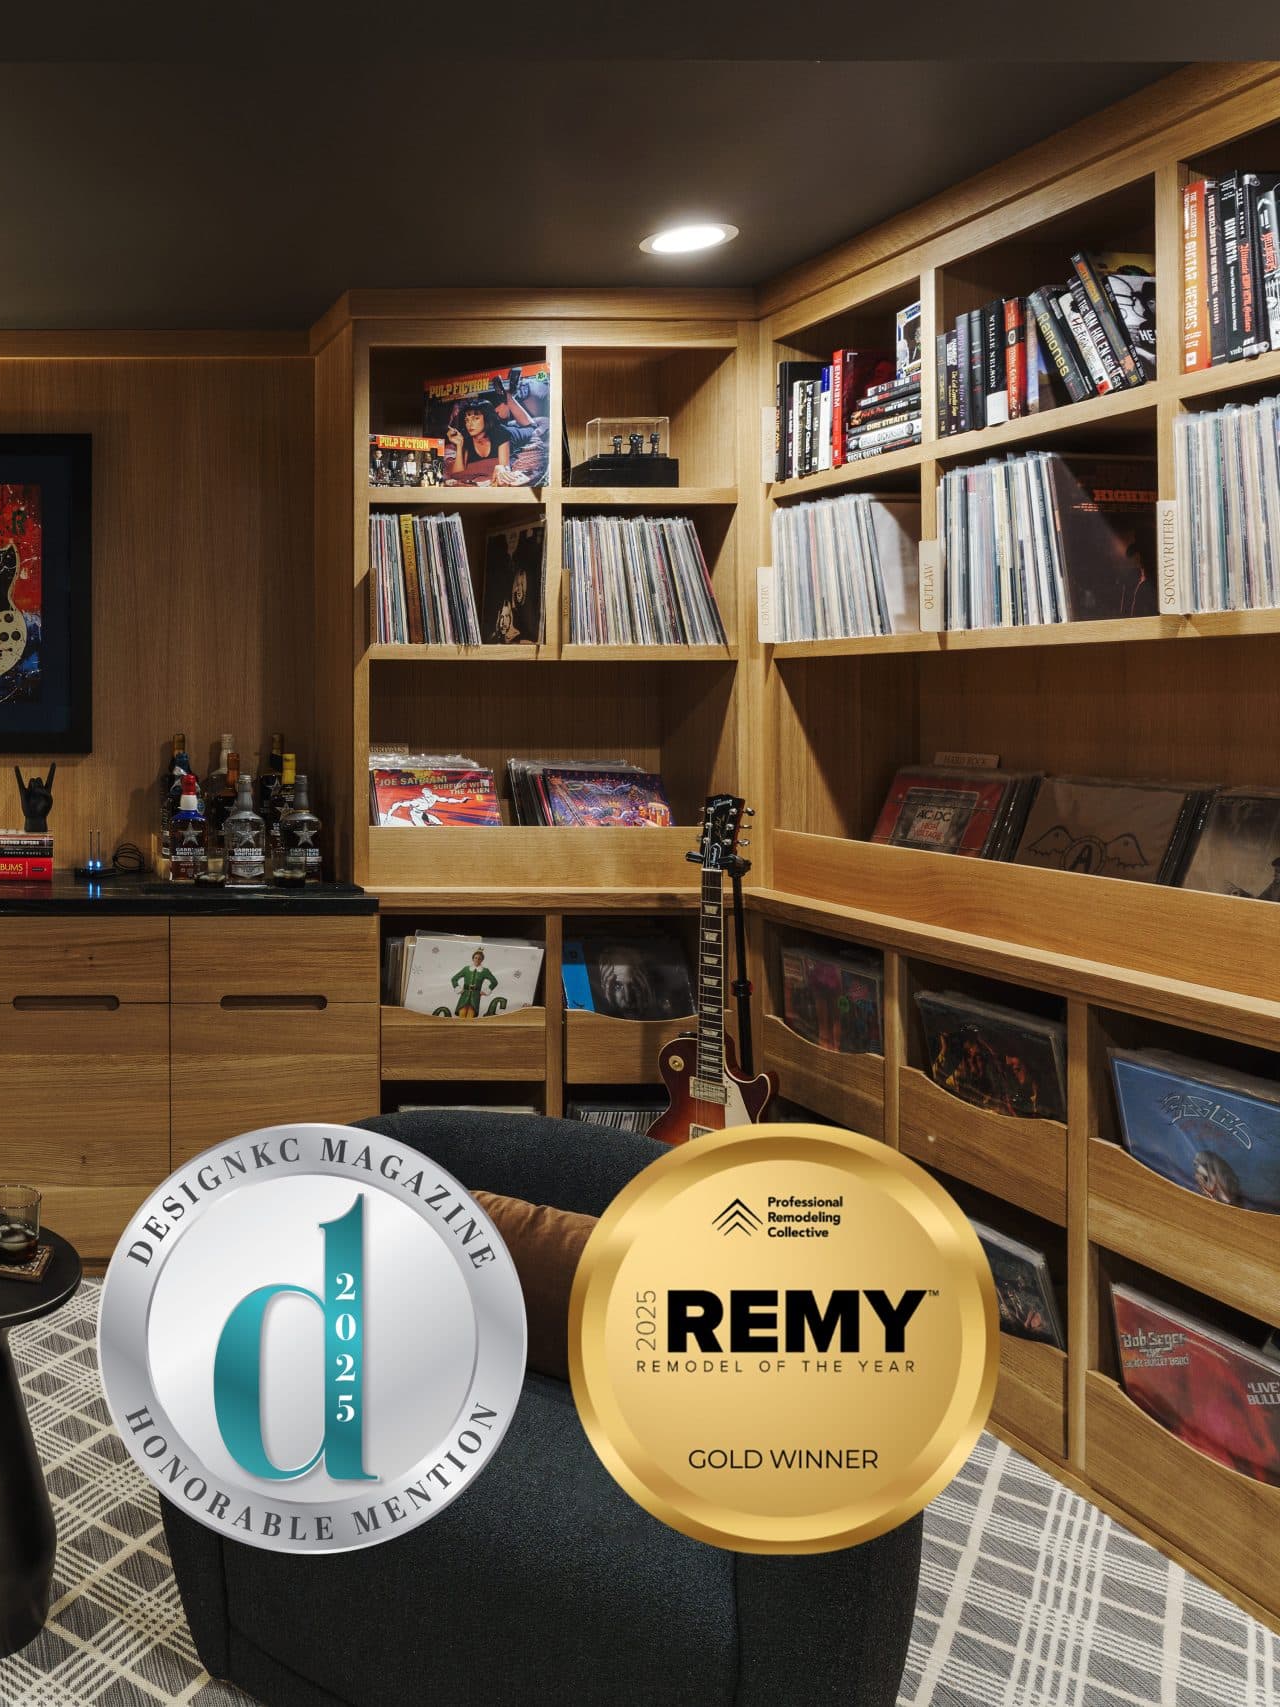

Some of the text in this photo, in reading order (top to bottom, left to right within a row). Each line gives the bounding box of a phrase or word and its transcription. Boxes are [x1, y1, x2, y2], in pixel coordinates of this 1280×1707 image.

[1224, 217, 1238, 265] HEAVY METAL
[1185, 241, 1198, 330] GUITAR HEROES
[1077, 299, 1089, 315] THE
[1084, 311, 1099, 330] VAN
[1037, 312, 1069, 377] Ramones
[1090, 328, 1109, 356] HALEN
[1101, 353, 1117, 373] SAGA
[428, 382, 452, 399] PULP
[452, 377, 490, 395] FICTION
[379, 437, 429, 449] PULP FICTION
[1162, 509, 1176, 606] SONGWRITERS
[924, 562, 936, 610] OUTLAW
[380, 775, 448, 786] JOE SATRIANI
[1121, 1327, 1188, 1351] Bob Seger
